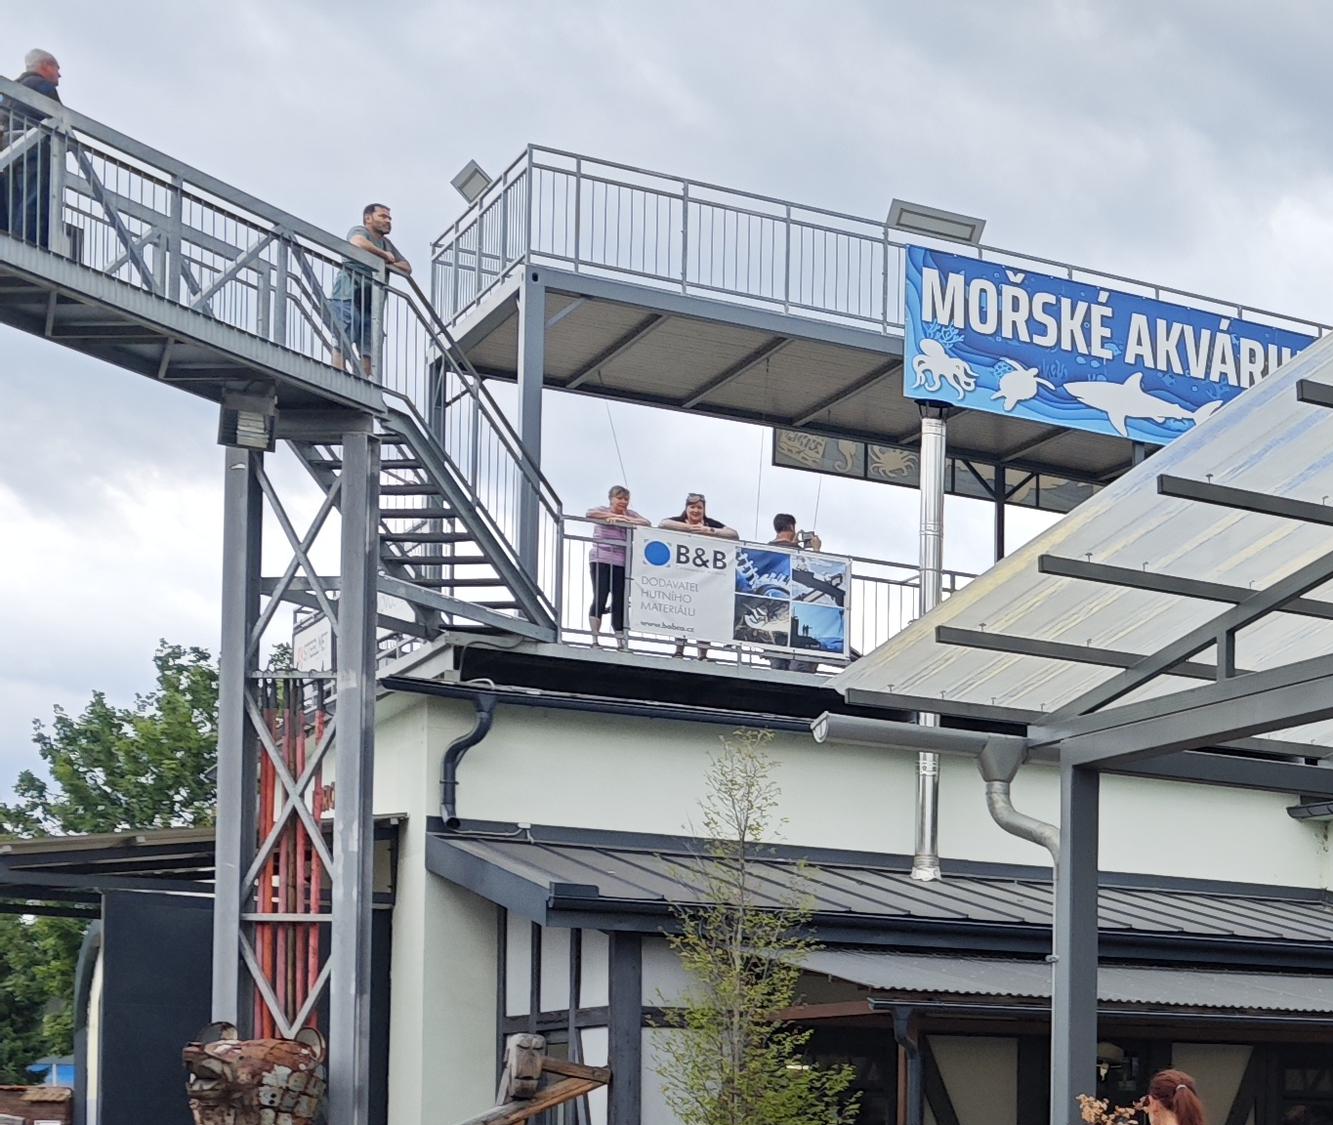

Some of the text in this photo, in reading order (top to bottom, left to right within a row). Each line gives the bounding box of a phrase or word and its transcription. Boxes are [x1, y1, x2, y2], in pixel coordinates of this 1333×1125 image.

[922, 267, 1303, 389] MOŘSKÉ AKVÁRI
[676, 544, 727, 570] B&B
[641, 576, 699, 593] DODAVATEL
[640, 589, 692, 604] HUTNÍHO
